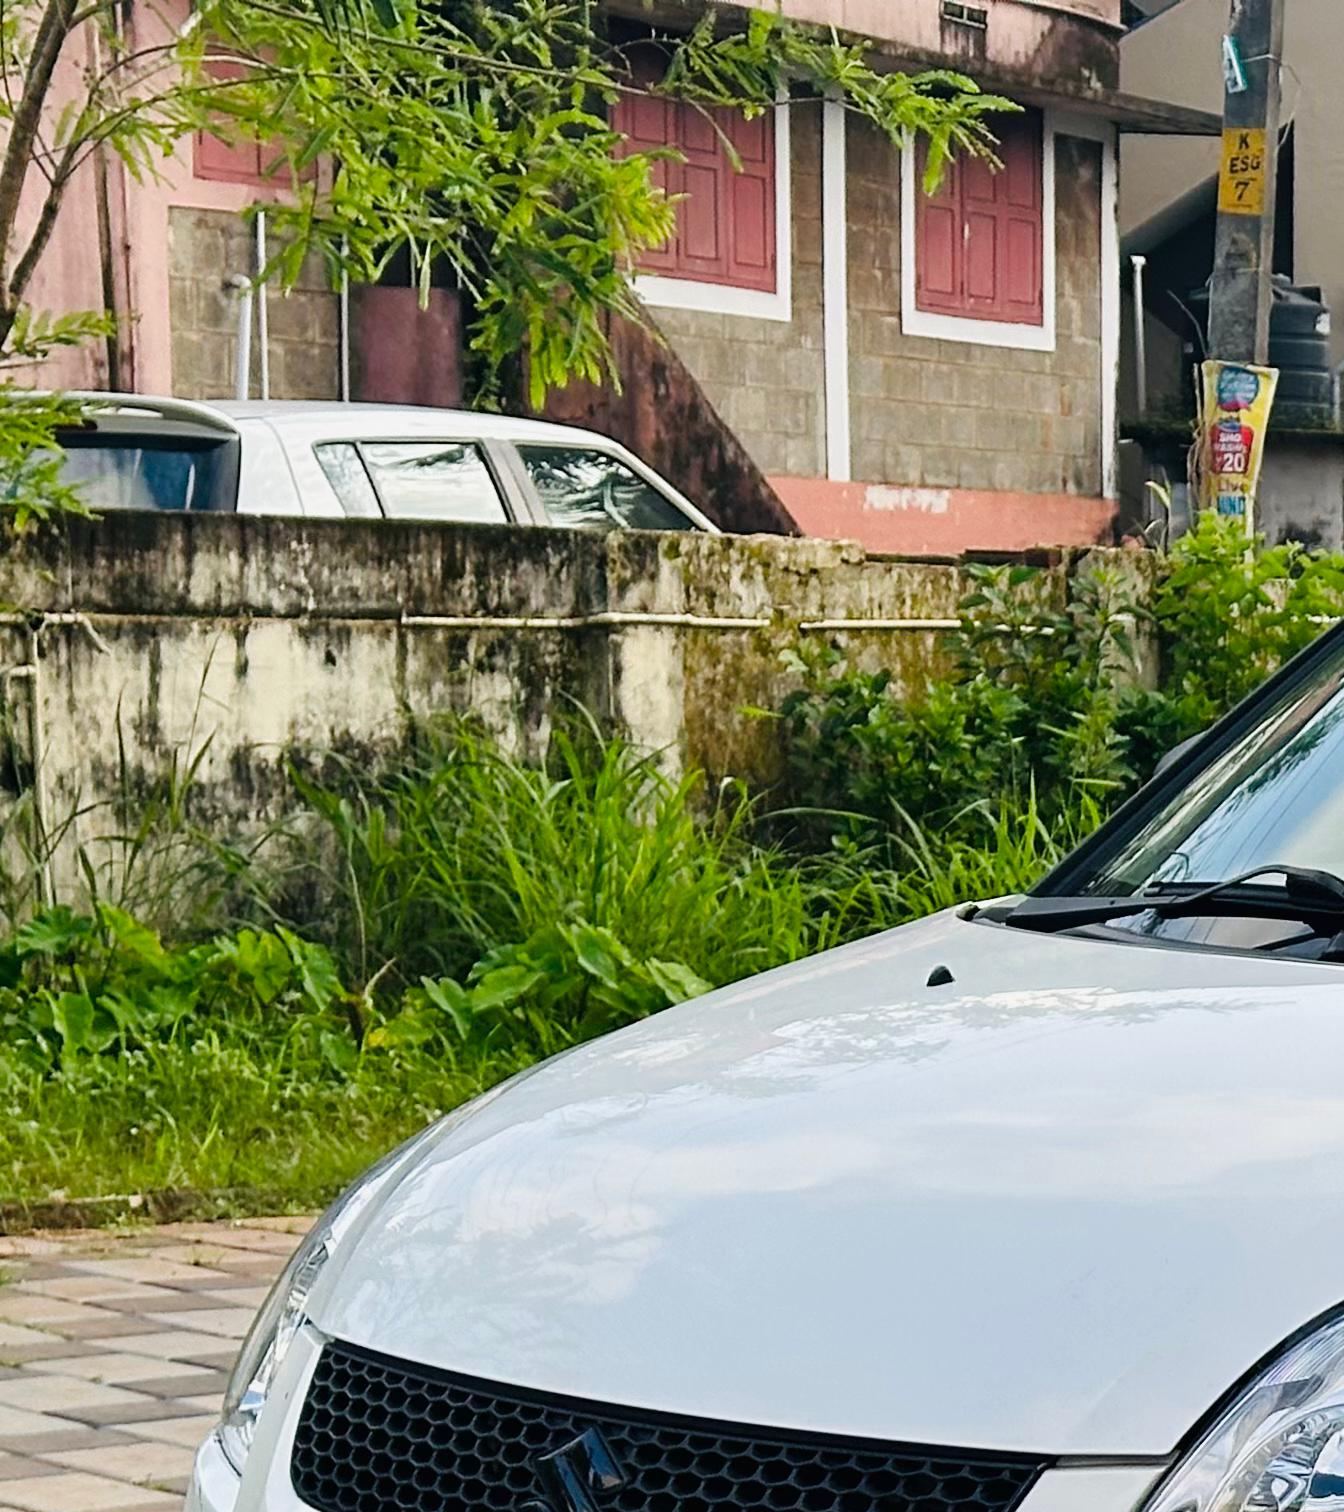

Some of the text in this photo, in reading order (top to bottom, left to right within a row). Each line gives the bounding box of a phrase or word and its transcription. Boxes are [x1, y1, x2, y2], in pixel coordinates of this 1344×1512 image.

[1239, 133, 1250, 149] K
[1229, 154, 1261, 174] ESG
[1234, 181, 1250, 201] 7
[1222, 452, 1246, 472] 20
